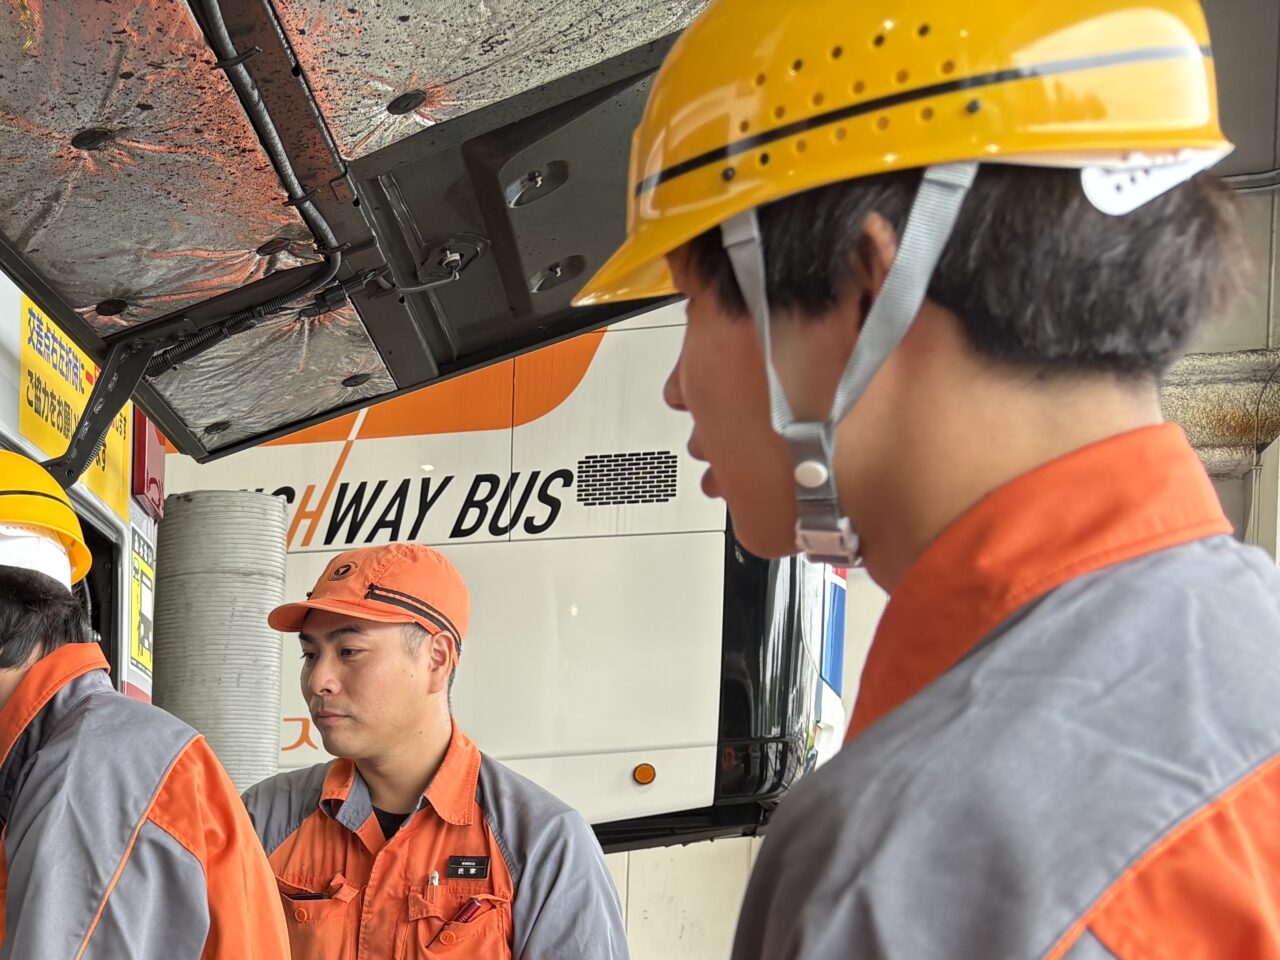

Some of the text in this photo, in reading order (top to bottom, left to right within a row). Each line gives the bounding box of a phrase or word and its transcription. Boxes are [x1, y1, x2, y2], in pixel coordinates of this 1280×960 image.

[27, 306, 101, 394] 交差点右左折時に一
[239, 440, 574, 548] HWAY BUS
